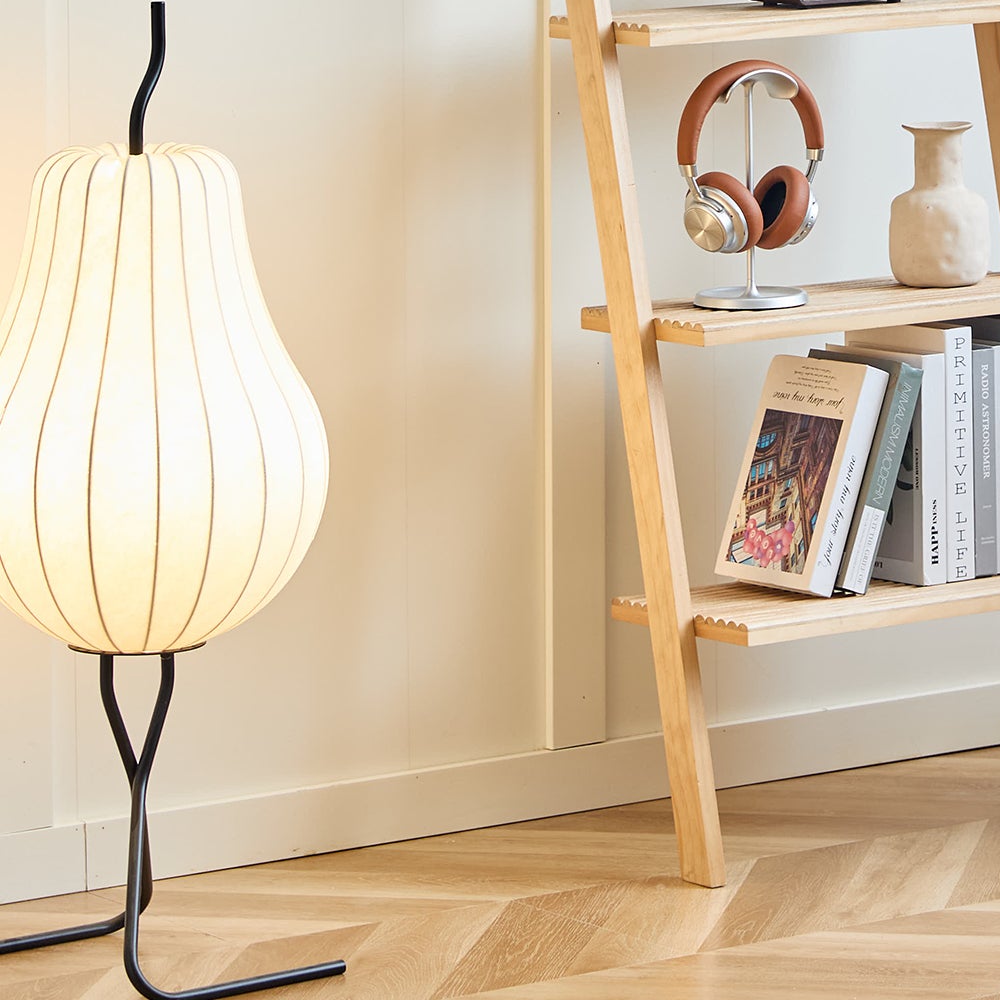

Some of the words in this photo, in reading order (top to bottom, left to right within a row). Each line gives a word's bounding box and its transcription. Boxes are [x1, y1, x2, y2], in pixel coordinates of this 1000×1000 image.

[981, 364, 990, 400] RADIO
[954, 337, 967, 495] PRIMITIVE
[981, 403, 991, 479] ASTRONOMER
[872, 449, 896, 505] MODERN
[955, 511, 968, 578] LIFE
